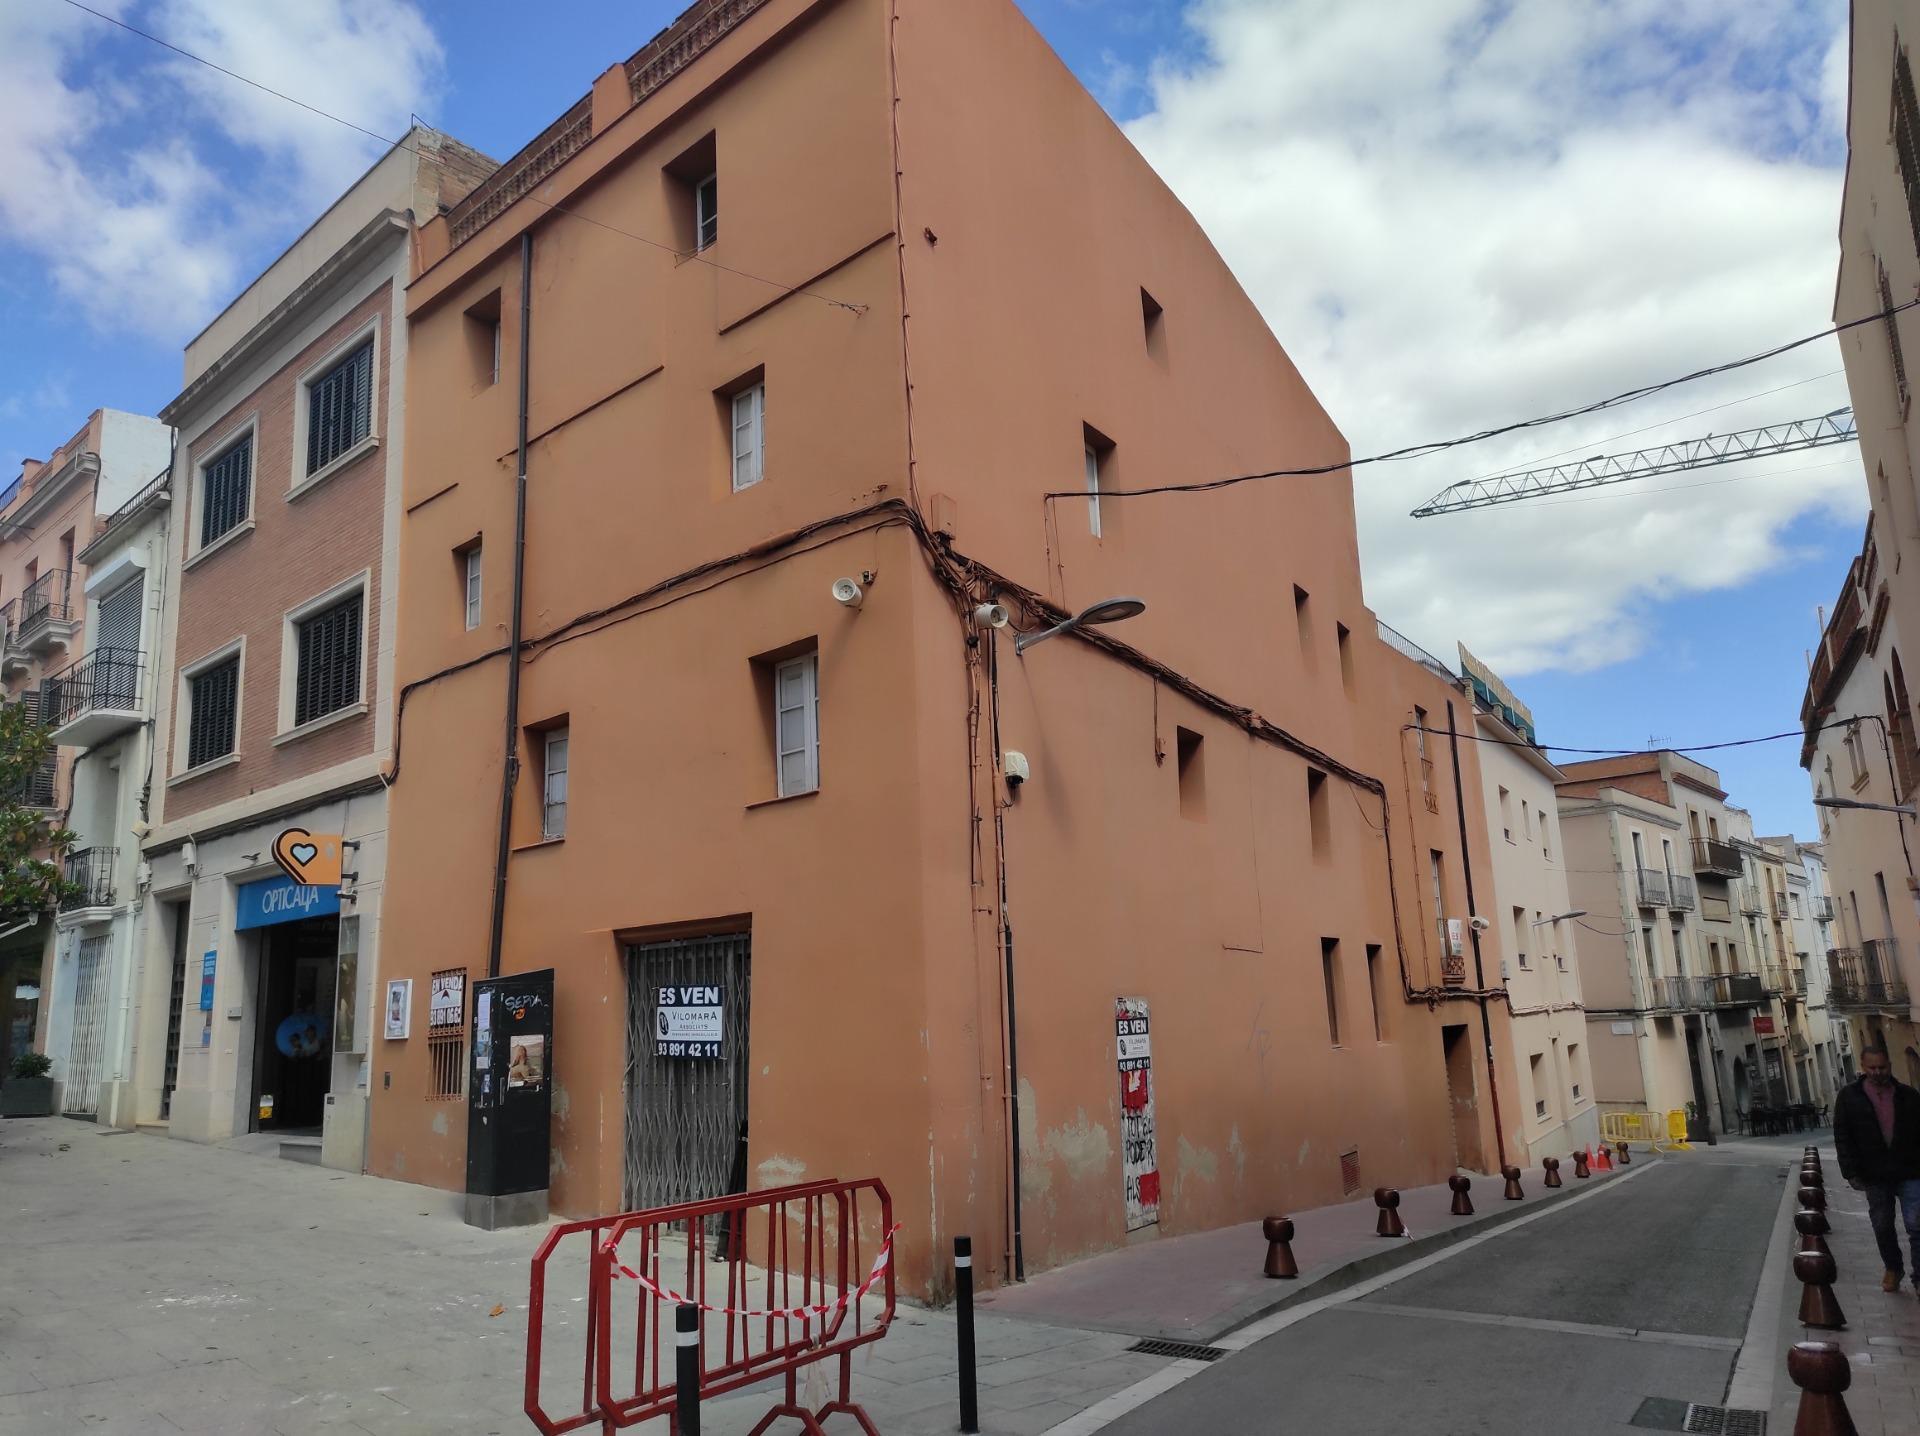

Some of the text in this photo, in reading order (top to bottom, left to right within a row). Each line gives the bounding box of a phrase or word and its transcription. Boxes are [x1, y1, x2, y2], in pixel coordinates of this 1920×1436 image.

[659, 987, 719, 1005] ES VEN
[1118, 1019, 1147, 1034] ES VEN
[658, 1042, 718, 1057] 93 891 42 11
